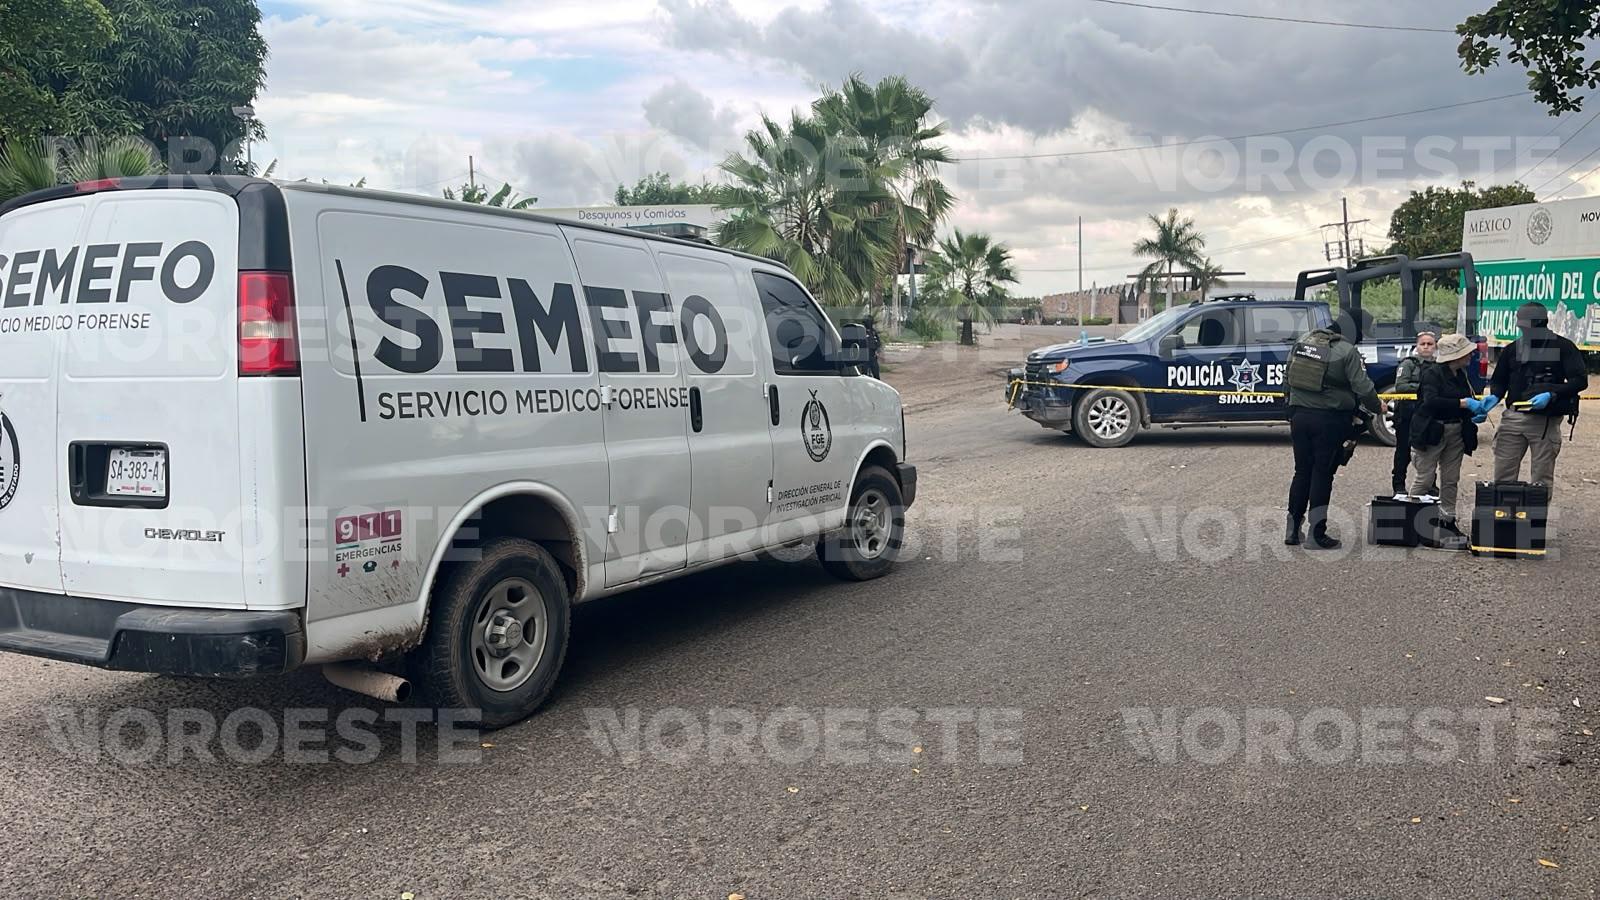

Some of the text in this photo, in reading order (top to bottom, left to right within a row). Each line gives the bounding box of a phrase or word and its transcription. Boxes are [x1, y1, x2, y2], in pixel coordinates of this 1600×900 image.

[578, 208, 686, 221] Desayunos y Comidas
[1469, 217, 1511, 233] MÉXICO
[1561, 271, 1585, 300] DEL
[0, 313, 151, 333] CIO MEDICO FORENSE
[366, 264, 729, 374] SEMEFO
[1167, 361, 1225, 387] POLICÍA
[378, 389, 508, 421] SERVICIO
[516, 388, 601, 414] MEDICO
[1218, 394, 1275, 404] SINALOA
[811, 433, 825, 445] FGE
[778, 480, 841, 500] DIRECCIÓN GENERAL DE
[776, 492, 841, 513] INVESTIGACIÓN PERICIAL
[144, 528, 226, 542] CHEVROLET
[340, 513, 395, 540] 911
[335, 543, 402, 562] EMERGENCIAS
